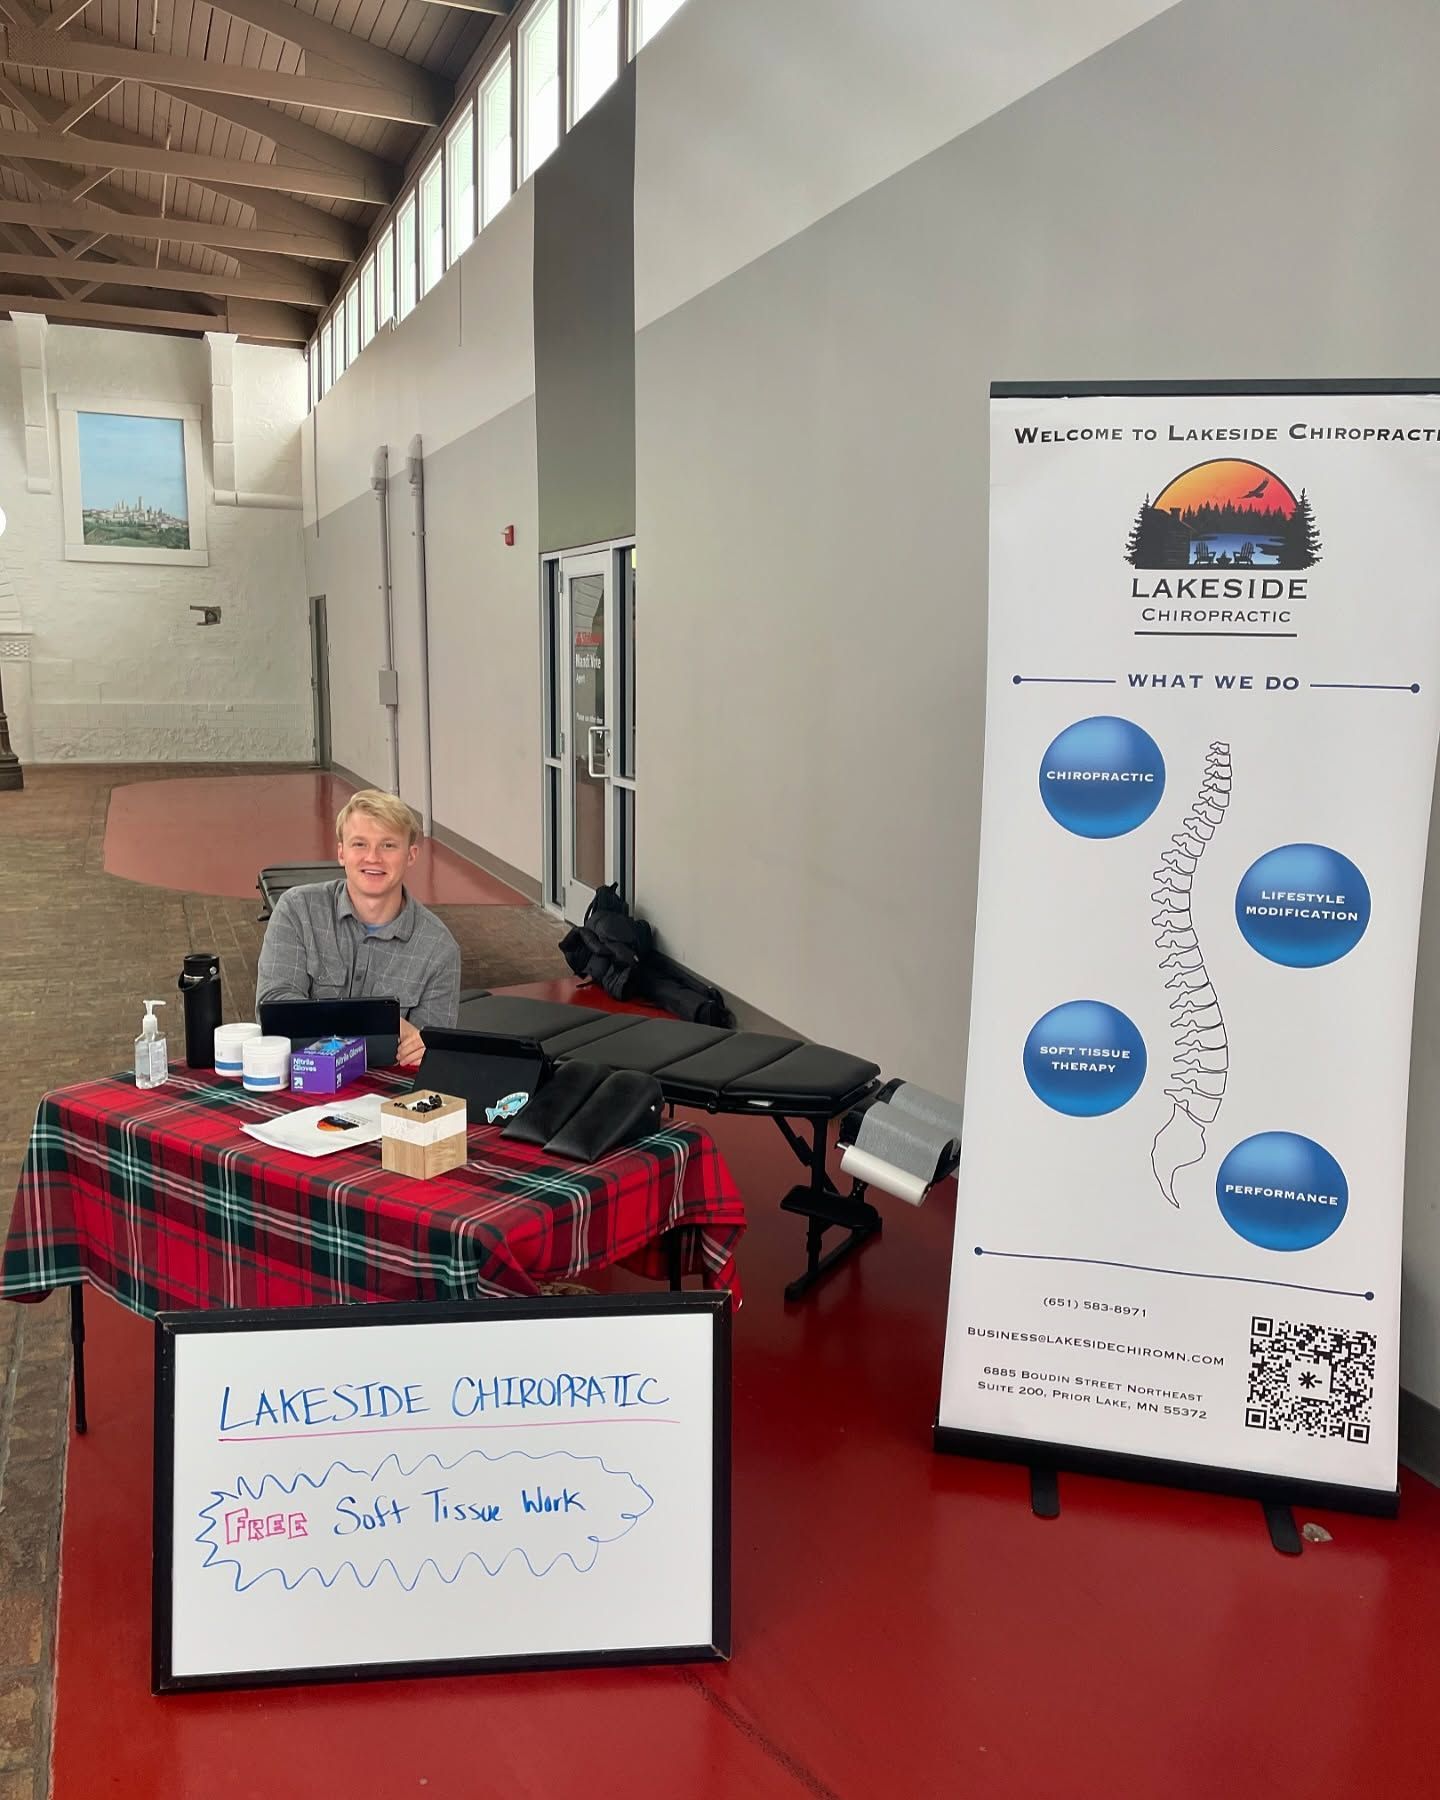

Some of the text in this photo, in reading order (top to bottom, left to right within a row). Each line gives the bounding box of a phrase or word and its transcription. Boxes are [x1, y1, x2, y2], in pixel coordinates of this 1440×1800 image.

[1014, 427, 1123, 444] WELCOME
[1132, 428, 1157, 441] TO
[1168, 424, 1278, 441] LAKESIDE
[1131, 578, 1308, 600] LAKESIDE
[1141, 607, 1291, 623] CHIROPRACTIC
[1127, 673, 1300, 691] WHAT WE DO
[1046, 770, 1154, 782] CHIROPRACTIC
[1261, 891, 1345, 904] LIFESTYLE
[1246, 906, 1358, 921] MODIFICATION
[1040, 1046, 1130, 1059] SOFT TISSUE
[1051, 1061, 1116, 1073] THERAPY
[1225, 1184, 1338, 1206] PERFORMANCE
[1043, 1297, 1146, 1318] (651) 583-8971
[967, 1326, 1224, 1366] BUSINESS@LAKESIDECHIROMN.COM
[983, 1366, 1204, 1403] 6885 BOUDIN STREET NORTHEAST
[218, 1372, 670, 1432] LAKESIDE CHIROPRATIC
[977, 1381, 1207, 1420] SUITE 200, PRIOR LAKE, MN 55372
[223, 1486, 586, 1546] FREE Soft Tissue Work
